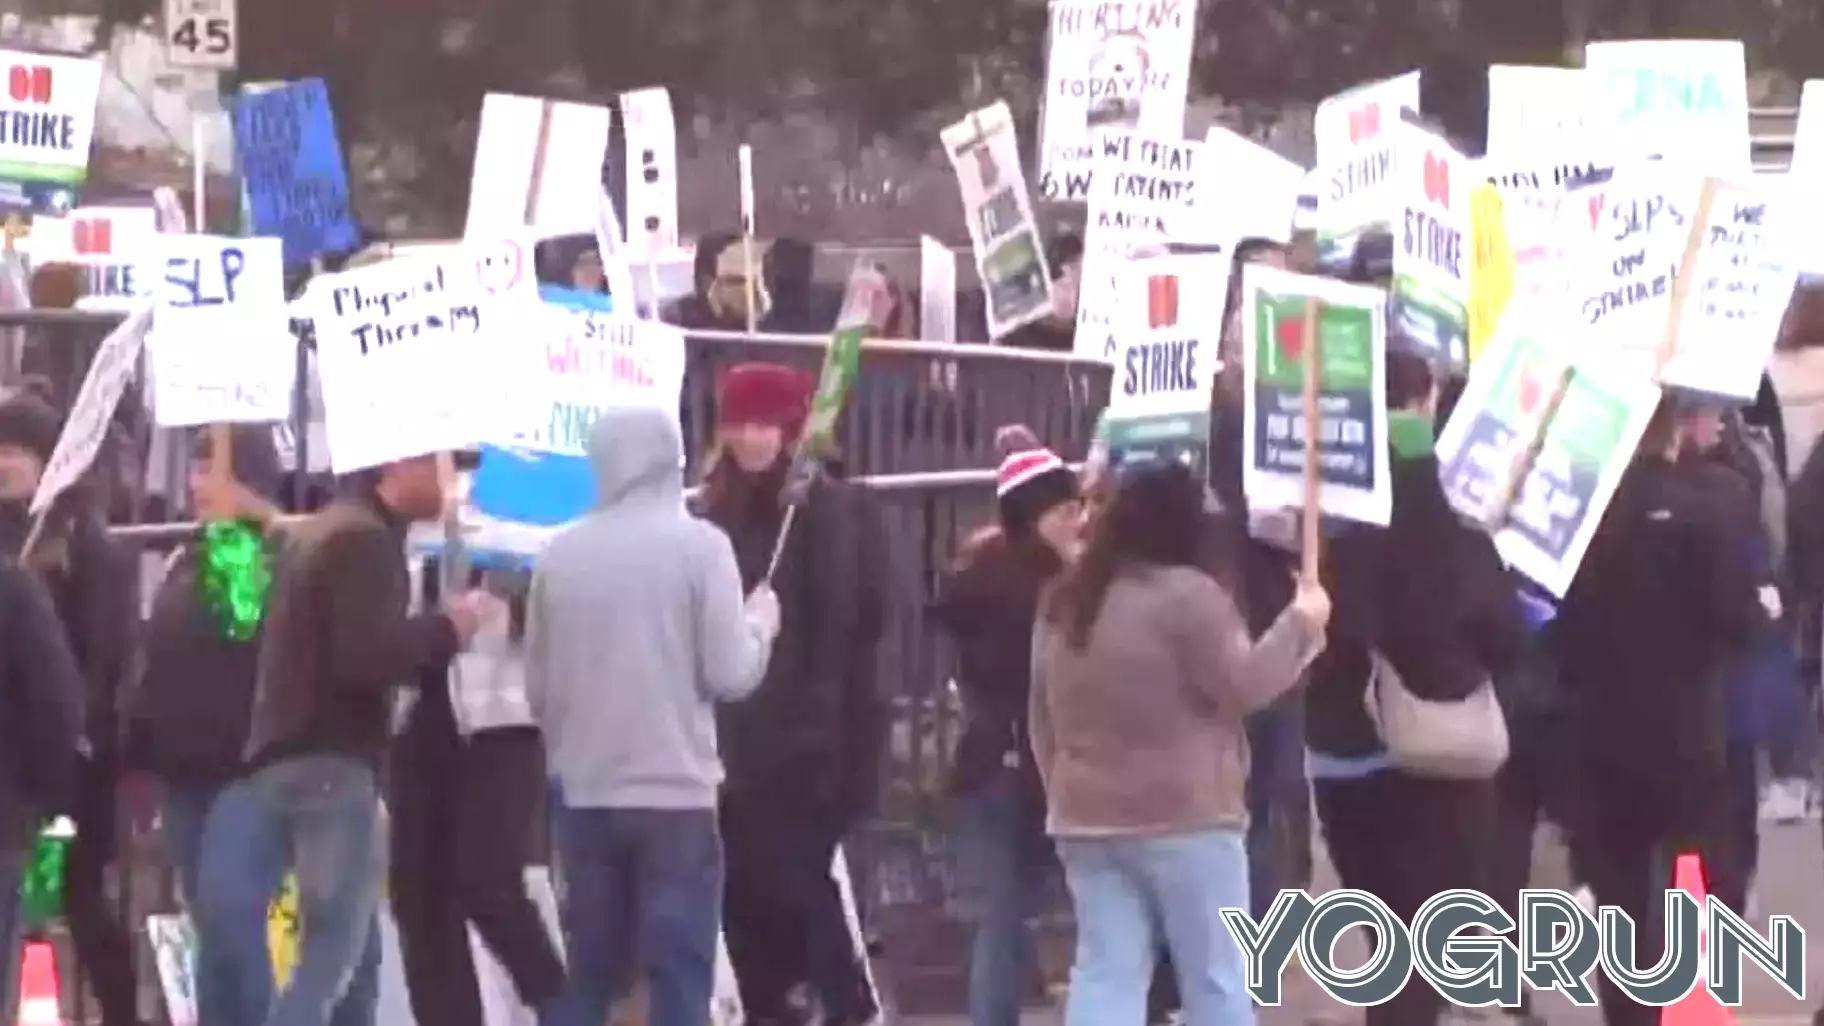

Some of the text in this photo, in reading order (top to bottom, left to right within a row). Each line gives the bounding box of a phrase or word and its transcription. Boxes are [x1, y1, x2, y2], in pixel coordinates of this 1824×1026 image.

[172, 18, 231, 54] 45
[1404, 206, 1462, 281] STRIKE
[164, 247, 244, 308] SLP
[1123, 338, 1199, 398] STRIKE
